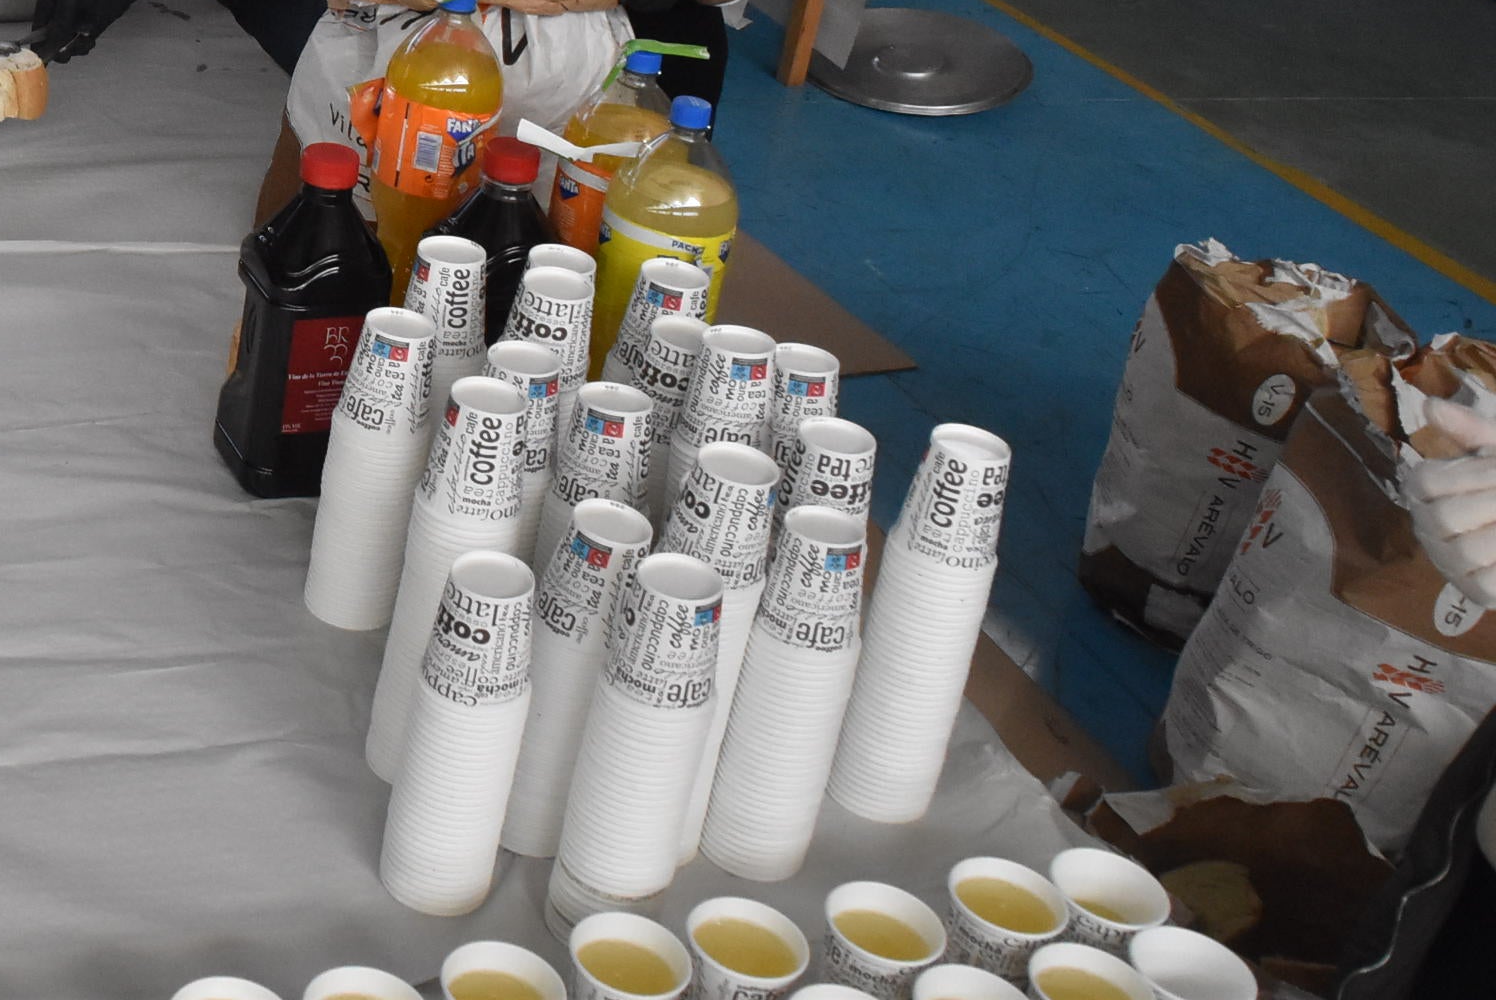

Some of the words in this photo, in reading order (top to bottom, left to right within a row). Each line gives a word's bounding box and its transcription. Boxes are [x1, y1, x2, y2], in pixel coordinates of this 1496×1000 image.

[446, 118, 480, 133] FAN
[440, 267, 450, 287] cafe
[445, 268, 471, 329] coffee
[524, 291, 575, 324] latte
[418, 342, 427, 362] cafe
[650, 340, 696, 368] atte
[385, 369, 406, 381] tea
[708, 353, 729, 395] coffee
[346, 395, 385, 426] cafe
[1257, 383, 1286, 418] V-15
[465, 411, 479, 435] cafe
[633, 415, 643, 438] cafe
[469, 416, 503, 486] coffee
[494, 422, 514, 506] cappuccino
[525, 447, 547, 467] ca
[598, 446, 622, 459] tea
[932, 451, 946, 475] cafe
[1233, 439, 1258, 460] H
[777, 438, 807, 507] coffee
[816, 453, 852, 482] tea
[558, 475, 600, 503] cafe
[690, 466, 725, 505] latt
[810, 479, 873, 505] ffee
[930, 458, 968, 529] coffee
[1217, 476, 1242, 490] V
[462, 496, 492, 507] mocha
[745, 488, 766, 532] coffee
[720, 488, 749, 557] cappuccino
[1176, 494, 1225, 577] ARÉVALO
[920, 535, 949, 550] mocha
[622, 549, 635, 571] cafe
[776, 537, 804, 607] cappuccino
[800, 543, 821, 588] coffee
[581, 571, 606, 588] tea
[445, 580, 499, 627] latte
[538, 591, 576, 632] cafe
[1443, 597, 1468, 628] -15
[505, 601, 523, 672] cappuccino
[641, 599, 669, 671] cappuccino
[669, 604, 690, 649] coffee
[796, 621, 845, 649] cafe
[1406, 654, 1438, 674] H
[422, 664, 478, 708] cappu
[476, 678, 520, 695] mocha
[615, 665, 657, 694] mocha
[666, 677, 712, 709] cafe
[1387, 691, 1413, 710] V
[1333, 710, 1396, 800] ARÉVAL
